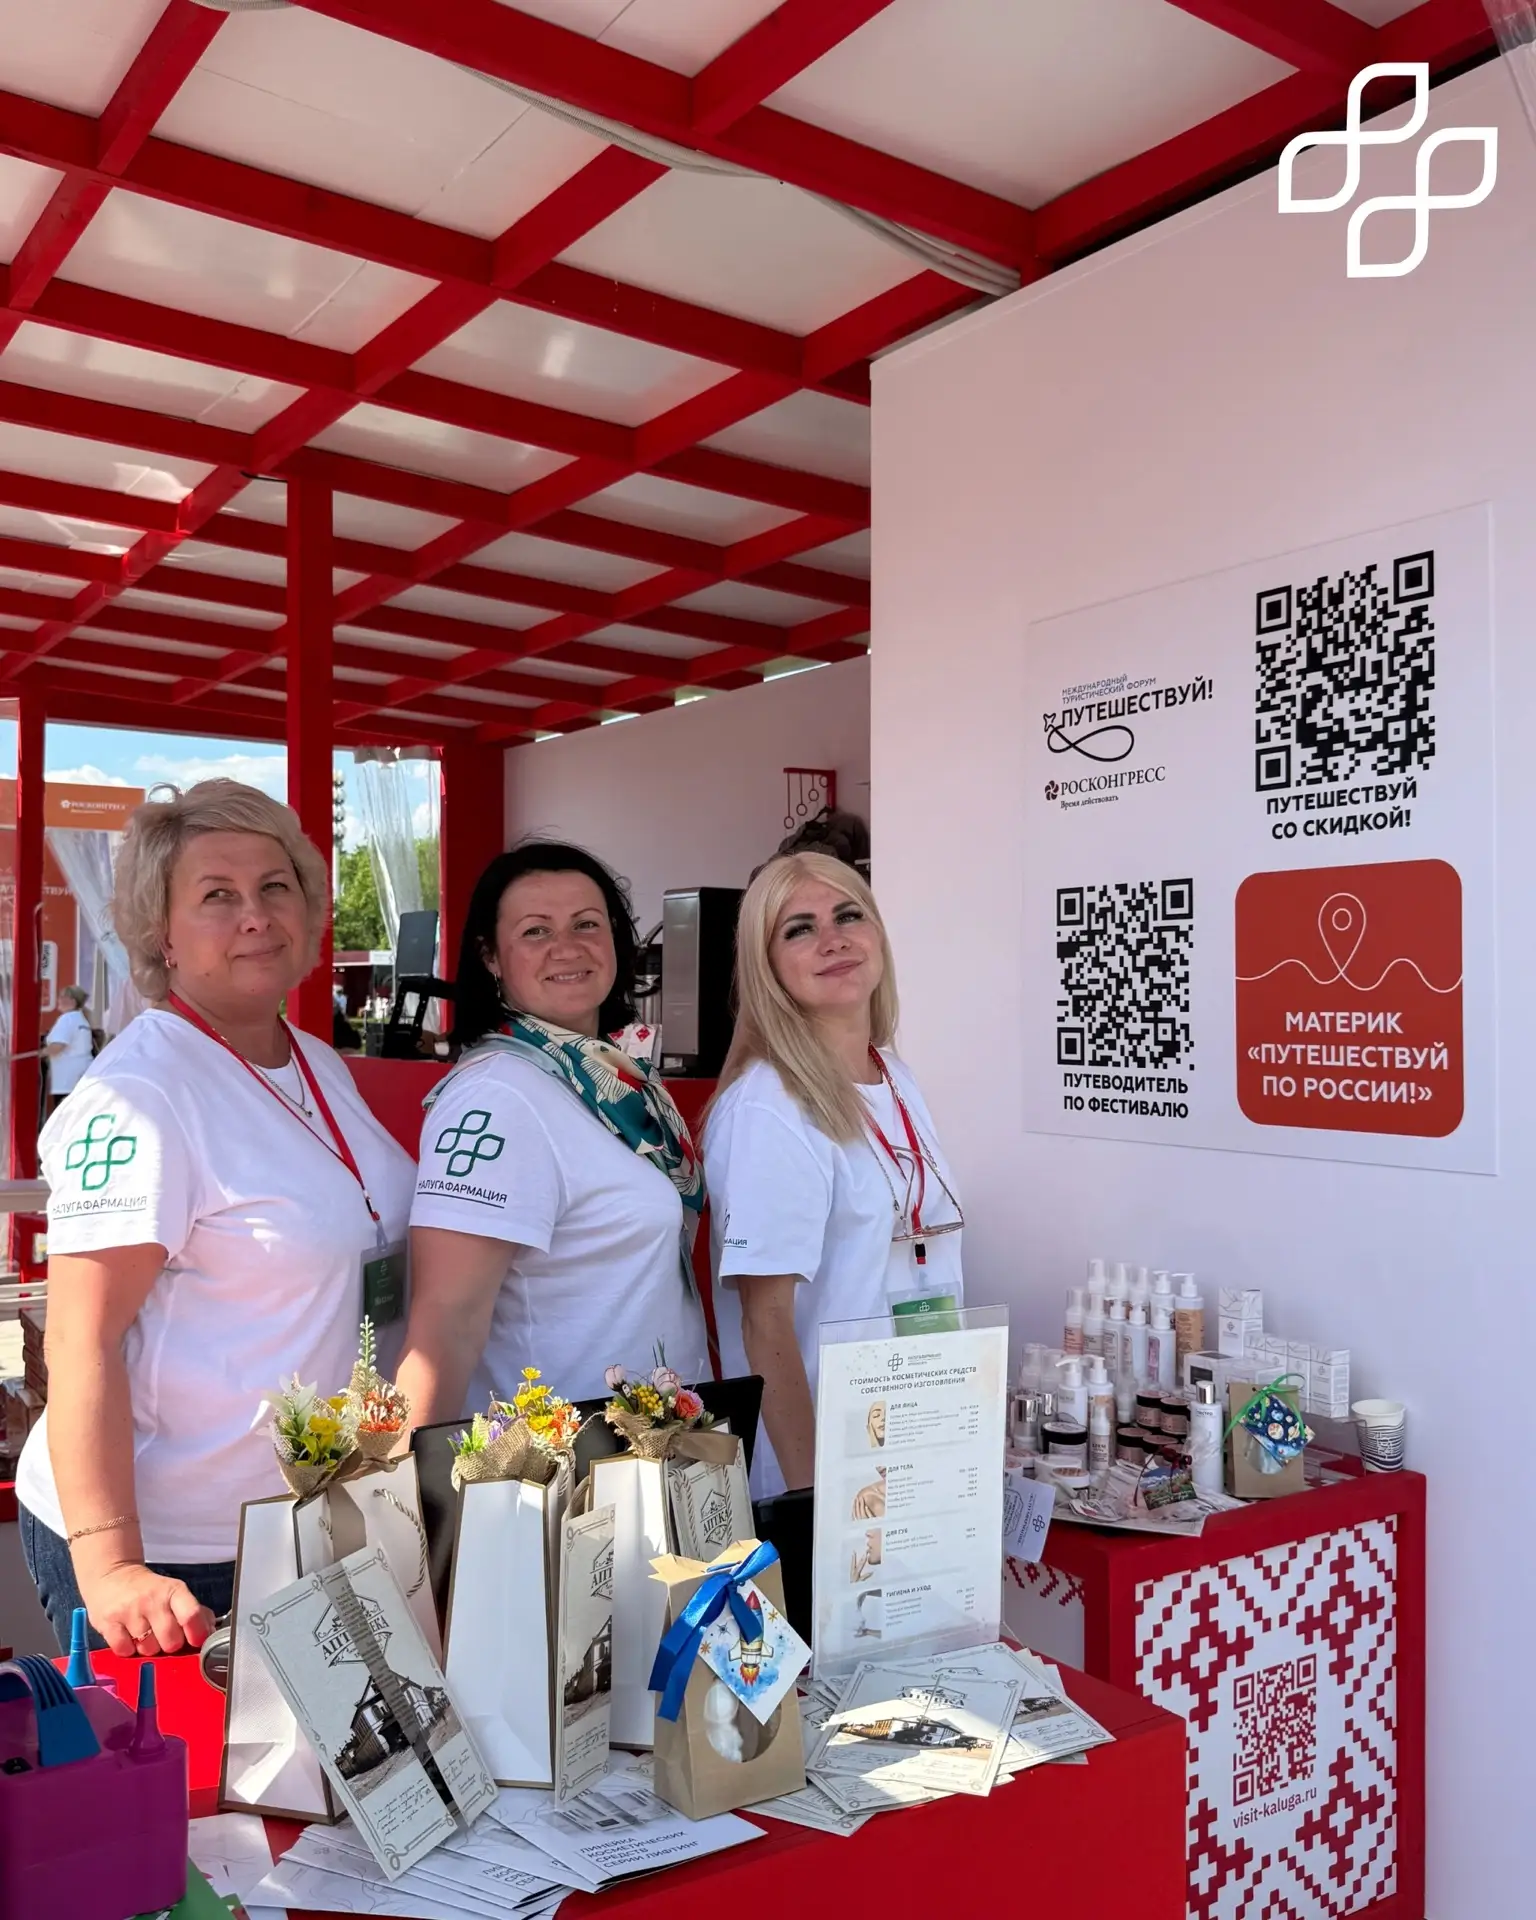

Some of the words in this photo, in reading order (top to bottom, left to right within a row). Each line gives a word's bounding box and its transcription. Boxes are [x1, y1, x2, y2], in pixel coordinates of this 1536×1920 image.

[1062, 674, 1128, 696] МЕЖДУНАРОДНЫЙ
[1062, 684, 1125, 704] ТУРИСТИЧЕСКИЙ
[1126, 677, 1157, 690] ФОРУМ
[1061, 675, 1213, 728] ПУТЕШЕСТВУЙ!
[1061, 766, 1166, 795] РОСКОНГРЕСС
[1060, 799, 1080, 811] Время
[1081, 794, 1119, 807] действовать
[1267, 776, 1417, 815] ПУТЕШЕСТВУЙ
[1272, 821, 1297, 840] СО
[1303, 805, 1411, 837] СКИДКОЙ!
[1285, 1011, 1404, 1034] МАТЕРИК
[1247, 1041, 1449, 1071] «ПУТЕШЕСТВУЙ
[1063, 1072, 1189, 1094] ПУТЕВОДИТЕЛЬ
[1262, 1075, 1297, 1098] ПО
[1303, 1077, 1433, 1105] РОССИИ!»
[1063, 1095, 1085, 1111] ПО
[1088, 1097, 1189, 1119] ФЕСТИВАЛЮ
[849, 1376, 891, 1386] СТОИМОСТЬ
[892, 1369, 948, 1381] КОСМЕТИЧЕСКИХ
[949, 1366, 977, 1375] СРЕДСТВ
[861, 1382, 913, 1394] СОБСТВЕННОГО
[914, 1377, 966, 1388] ИЗГОТОВЛЕНИЯ
[1233, 1787, 1316, 1829] visit-kaluga.ru
[580, 1837, 637, 1854] ЛИНЕЙКА
[587, 1830, 688, 1858] КОСМЕТИЧЕСКИХ
[595, 1847, 649, 1863] СРЕДСТВ
[603, 1855, 645, 1868] СЕРИИ
[646, 1840, 699, 1859] ЛИФТИНГ
